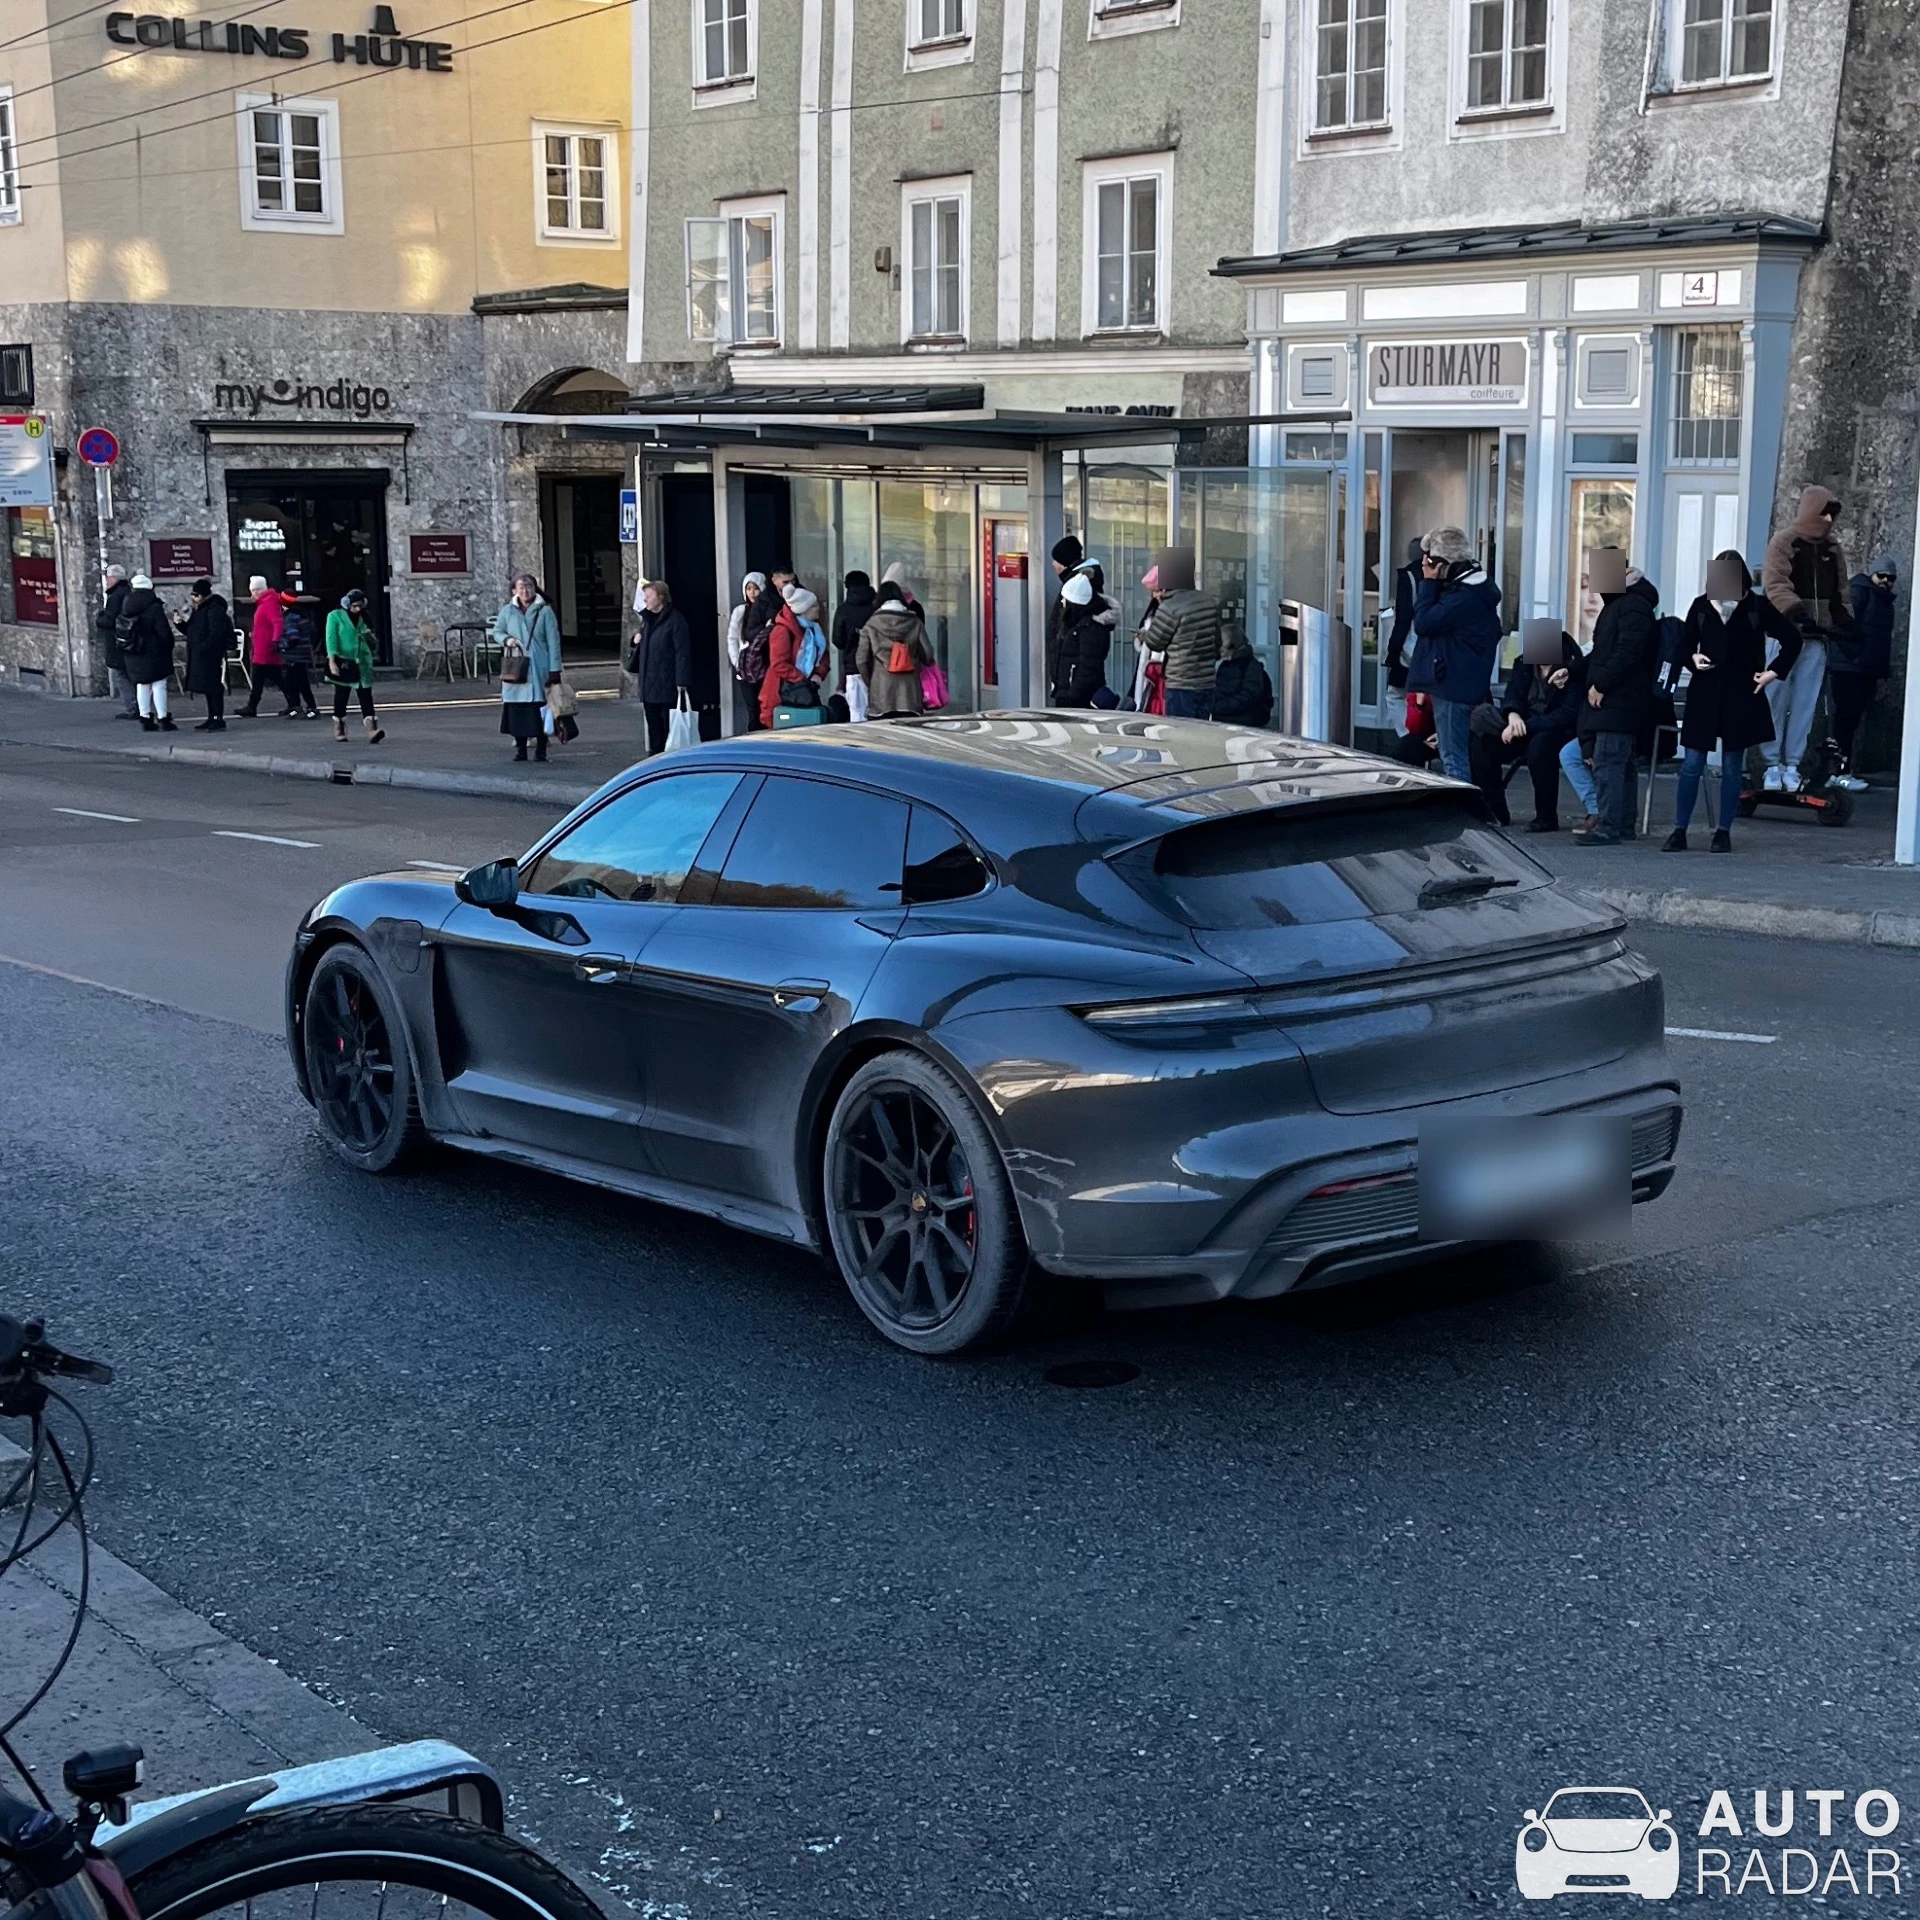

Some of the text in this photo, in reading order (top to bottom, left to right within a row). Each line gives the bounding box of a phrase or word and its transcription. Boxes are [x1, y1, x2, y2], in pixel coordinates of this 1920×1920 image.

[105, 11, 309, 60] COLLINS
[1691, 276, 1704, 293] 4
[1379, 343, 1500, 387] STURMAYR
[215, 377, 390, 418] my indigo
[1470, 387, 1515, 399] coiffeure
[29, 422, 40, 434] H
[244, 518, 278, 531] Super
[239, 529, 285, 540] Natural
[239, 540, 286, 551] Kitchen
